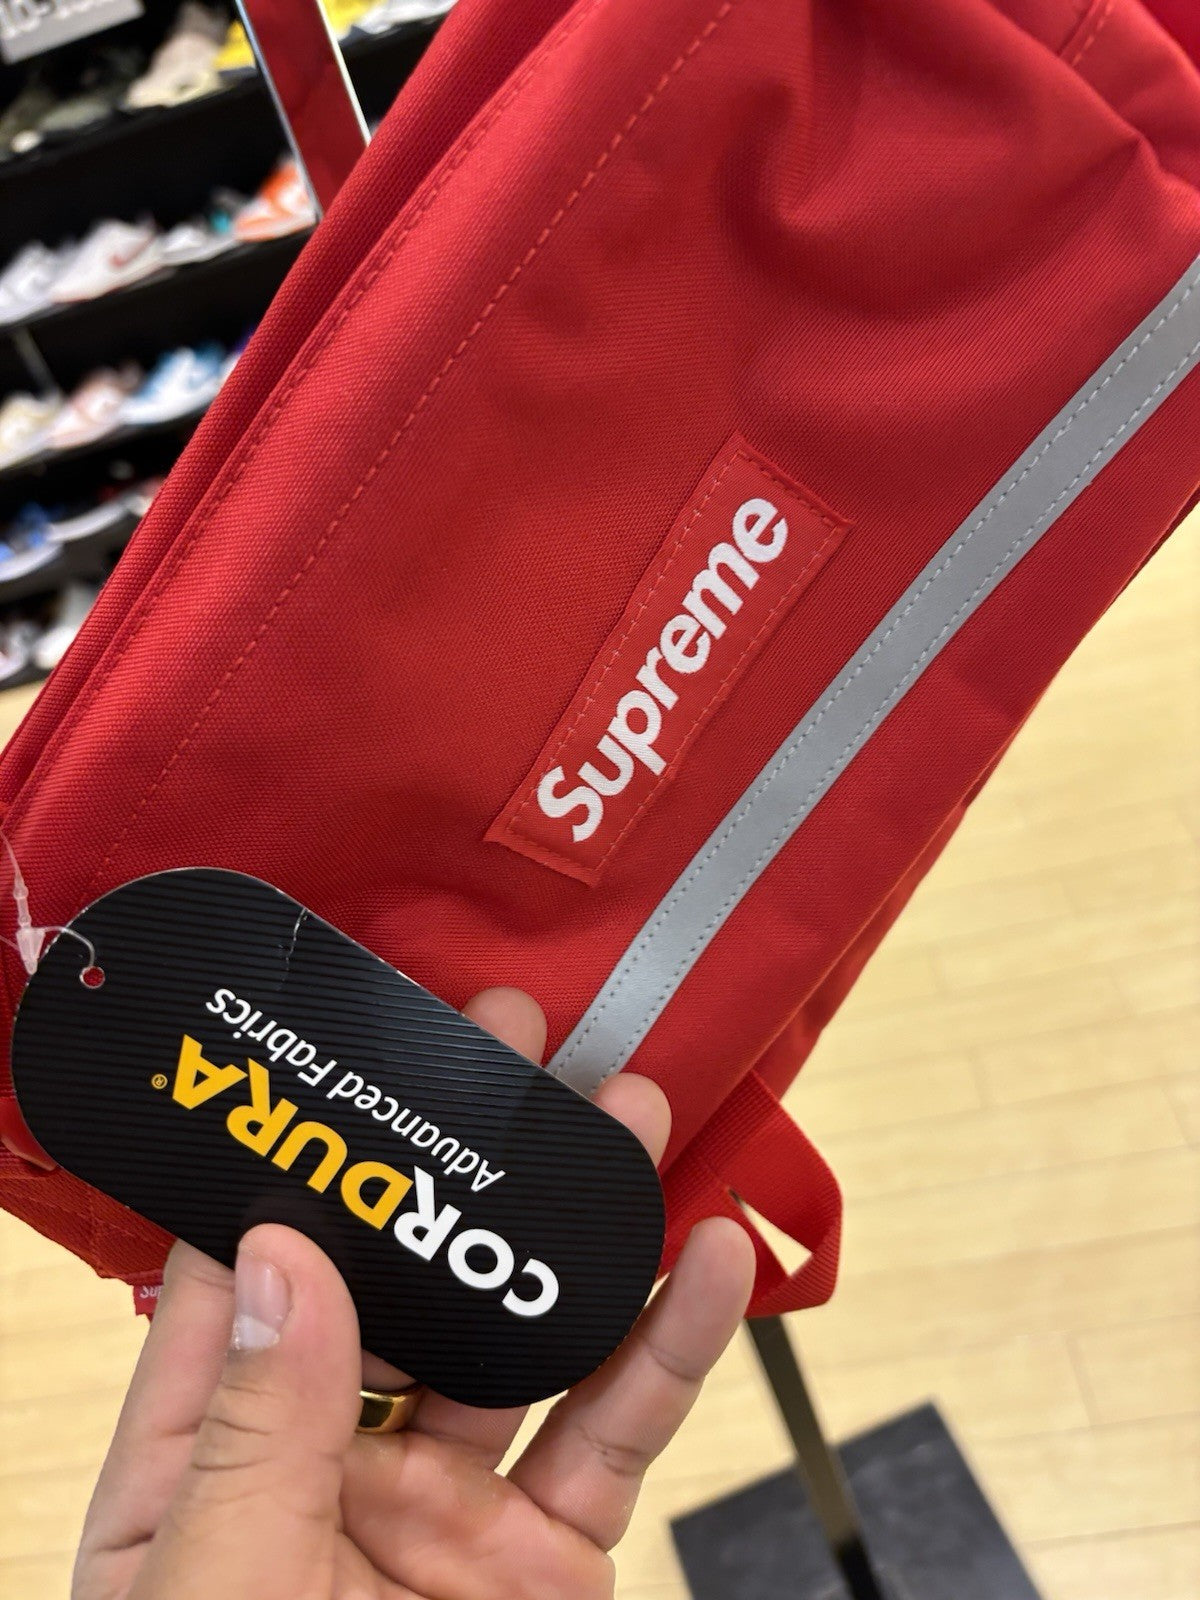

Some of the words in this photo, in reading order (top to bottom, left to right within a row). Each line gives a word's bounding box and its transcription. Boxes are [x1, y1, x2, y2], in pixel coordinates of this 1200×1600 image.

[537, 498, 788, 843] Supreme
[206, 988, 336, 1087] Fabrics
[326, 1072, 506, 1192] Advanced
